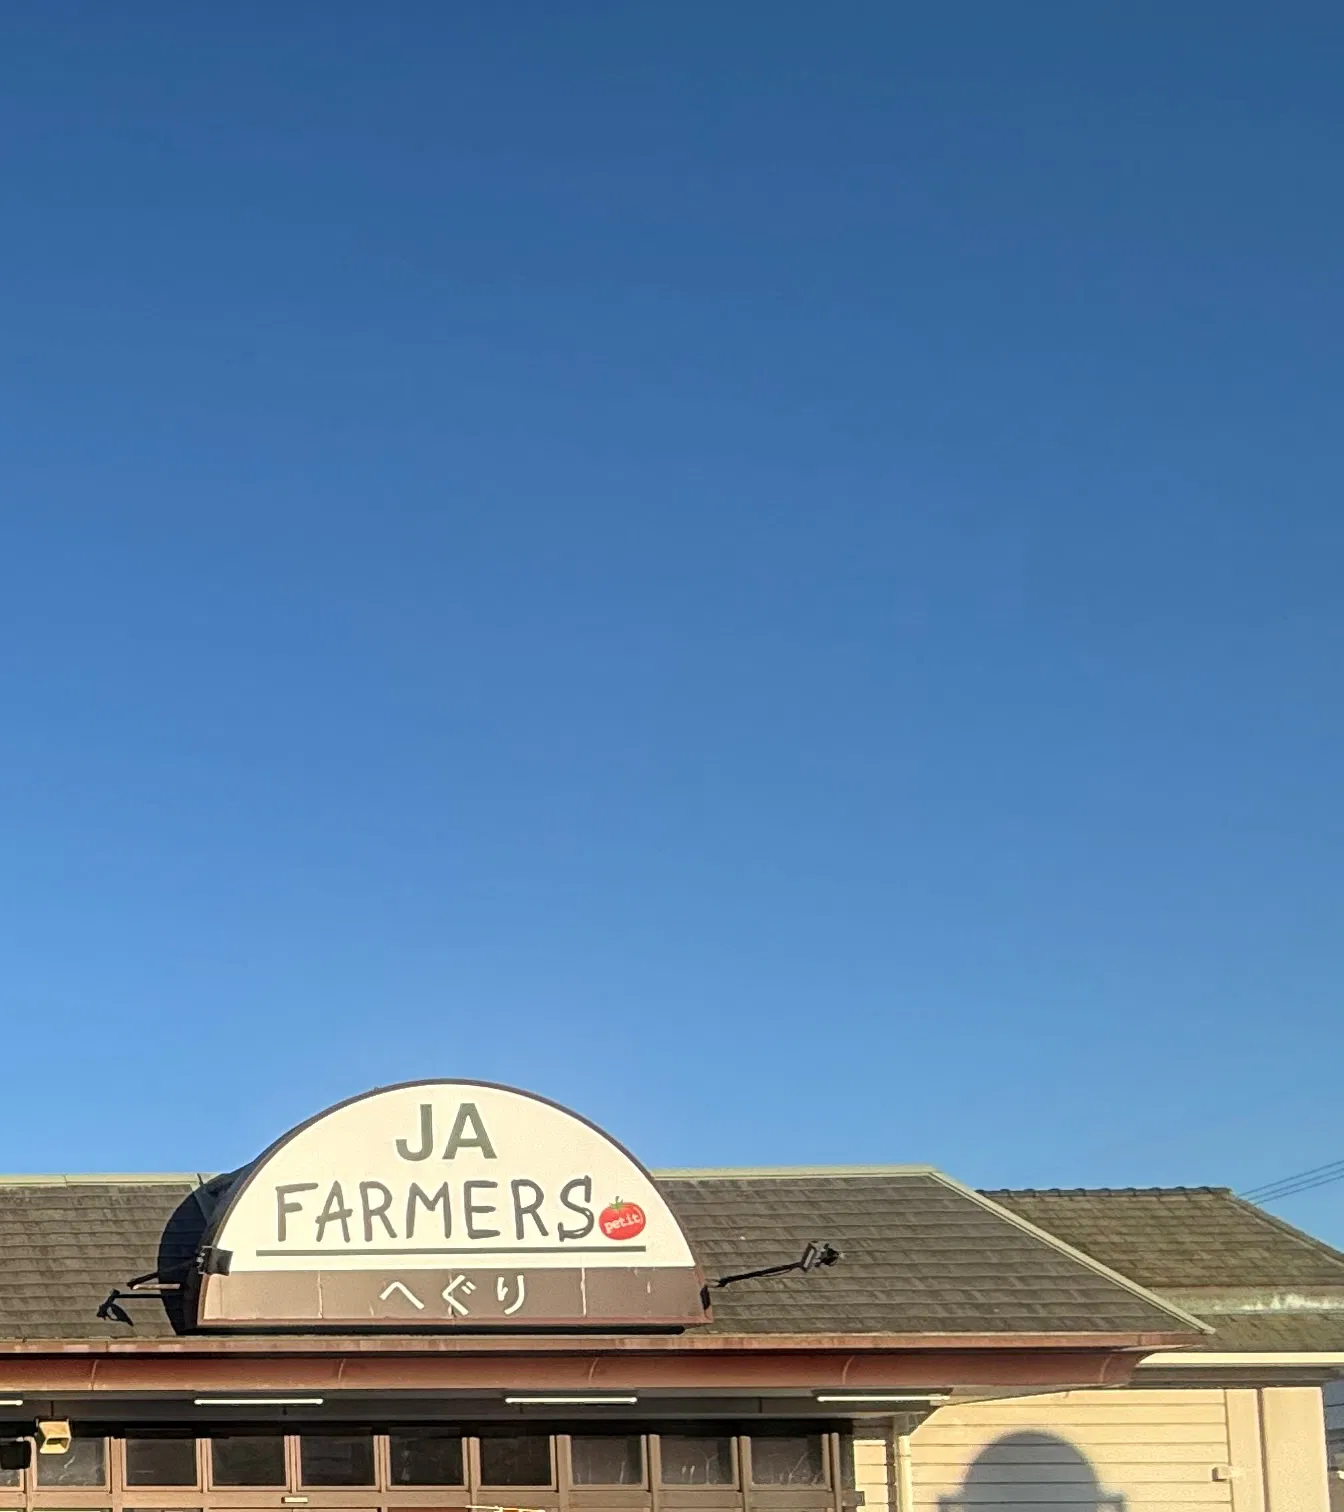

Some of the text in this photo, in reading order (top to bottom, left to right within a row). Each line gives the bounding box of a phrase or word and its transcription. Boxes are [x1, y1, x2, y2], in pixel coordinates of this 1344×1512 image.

[395, 1102, 498, 1162] JA
[274, 1174, 595, 1243] FARMERS
[603, 1212, 641, 1235] petit
[379, 1274, 527, 1316] へぐり
